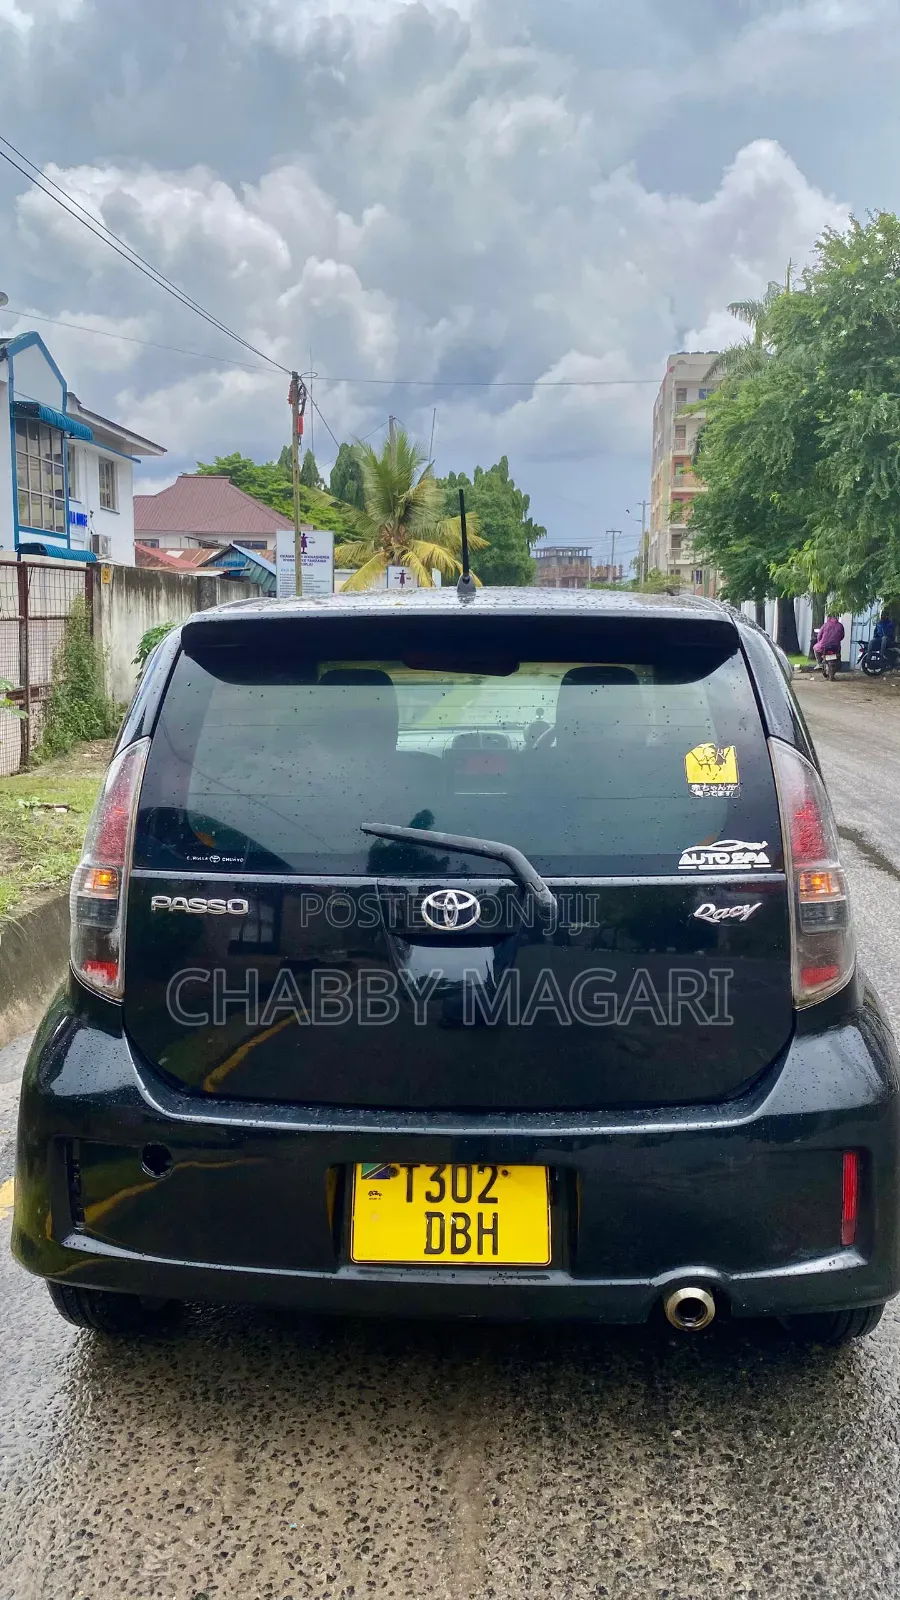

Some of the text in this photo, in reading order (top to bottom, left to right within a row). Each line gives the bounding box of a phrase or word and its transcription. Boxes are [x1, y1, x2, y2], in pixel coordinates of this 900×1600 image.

[678, 851, 770, 865] AUTO SPA
[151, 895, 249, 915] PASSO
[400, 1164, 499, 1204] T302
[424, 1211, 499, 1256] DBH
